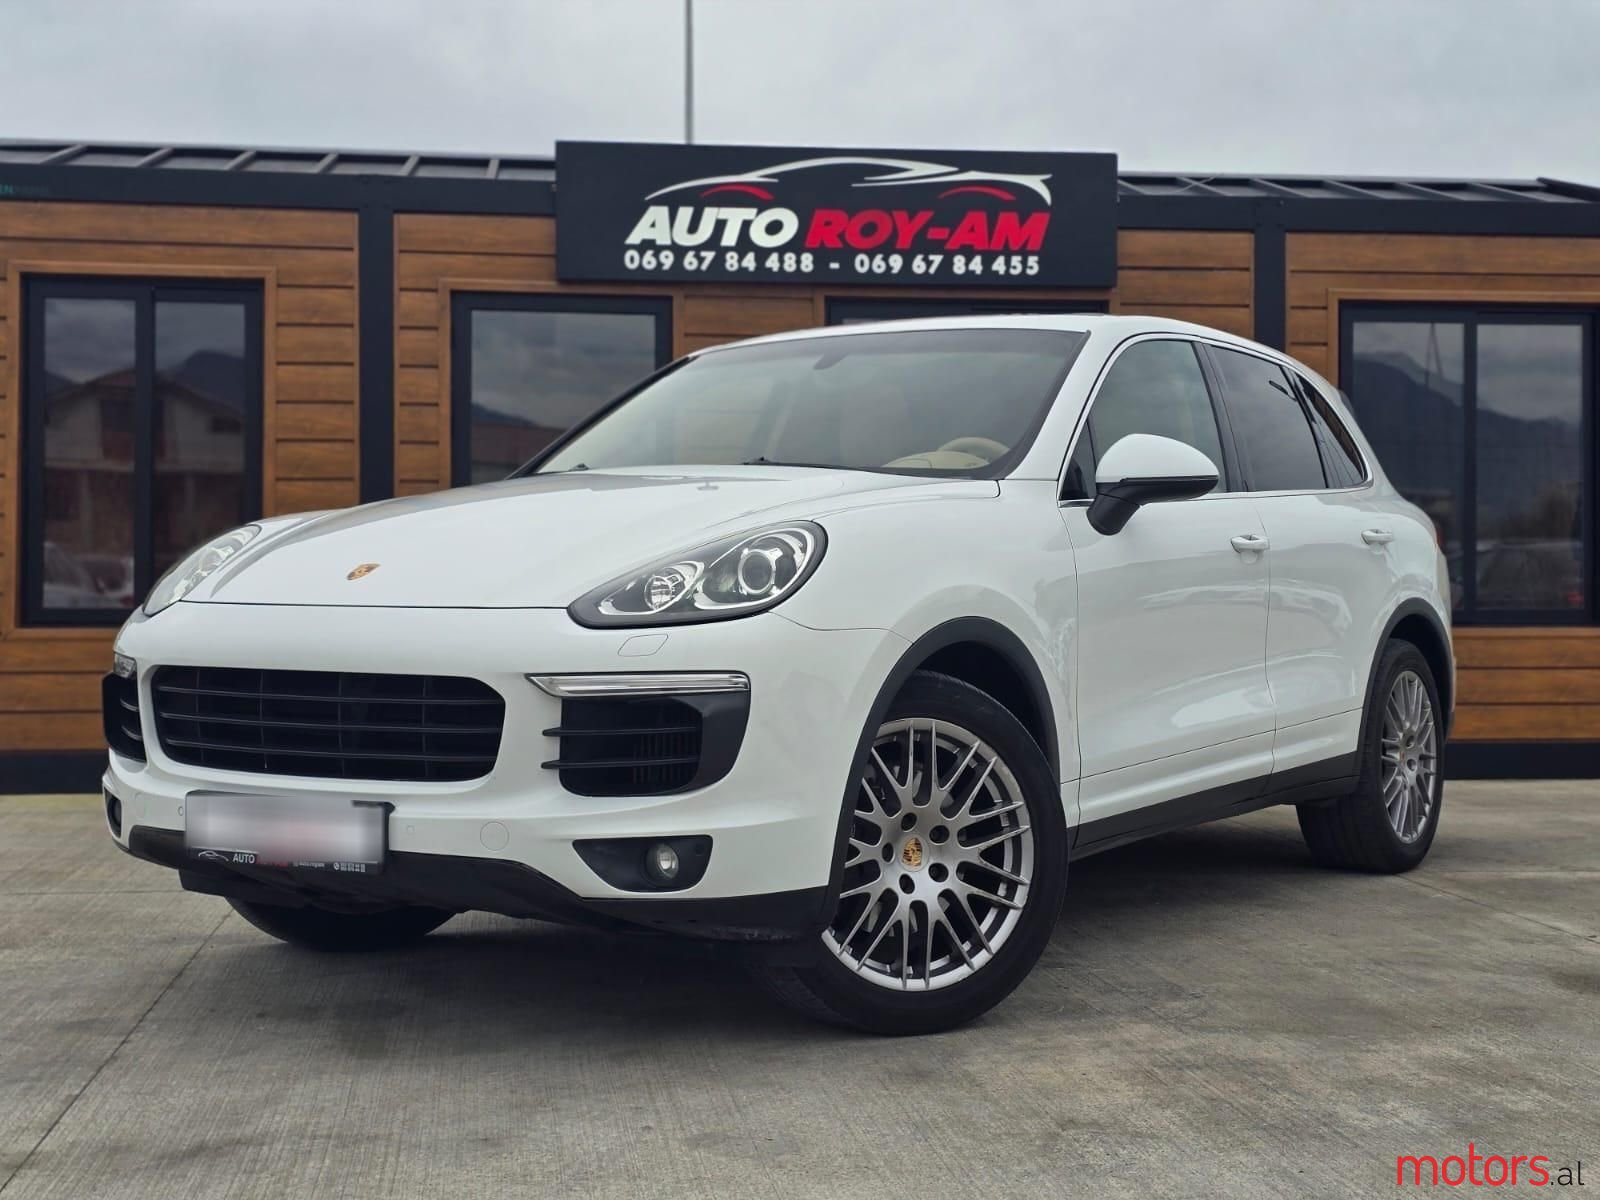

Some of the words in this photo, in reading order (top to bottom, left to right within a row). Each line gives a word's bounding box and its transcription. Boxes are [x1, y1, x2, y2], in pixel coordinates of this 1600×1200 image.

[624, 205, 799, 248] AUTO
[804, 207, 1051, 251] ROY-AM
[624, 249, 674, 271] 069
[683, 251, 716, 272] 67
[725, 251, 756, 272] 84
[765, 252, 814, 273] 488
[854, 253, 903, 274] 069
[912, 254, 944, 275] 67
[952, 254, 983, 275] 84
[991, 255, 1040, 275] 455
[232, 853, 256, 864] AUTO
